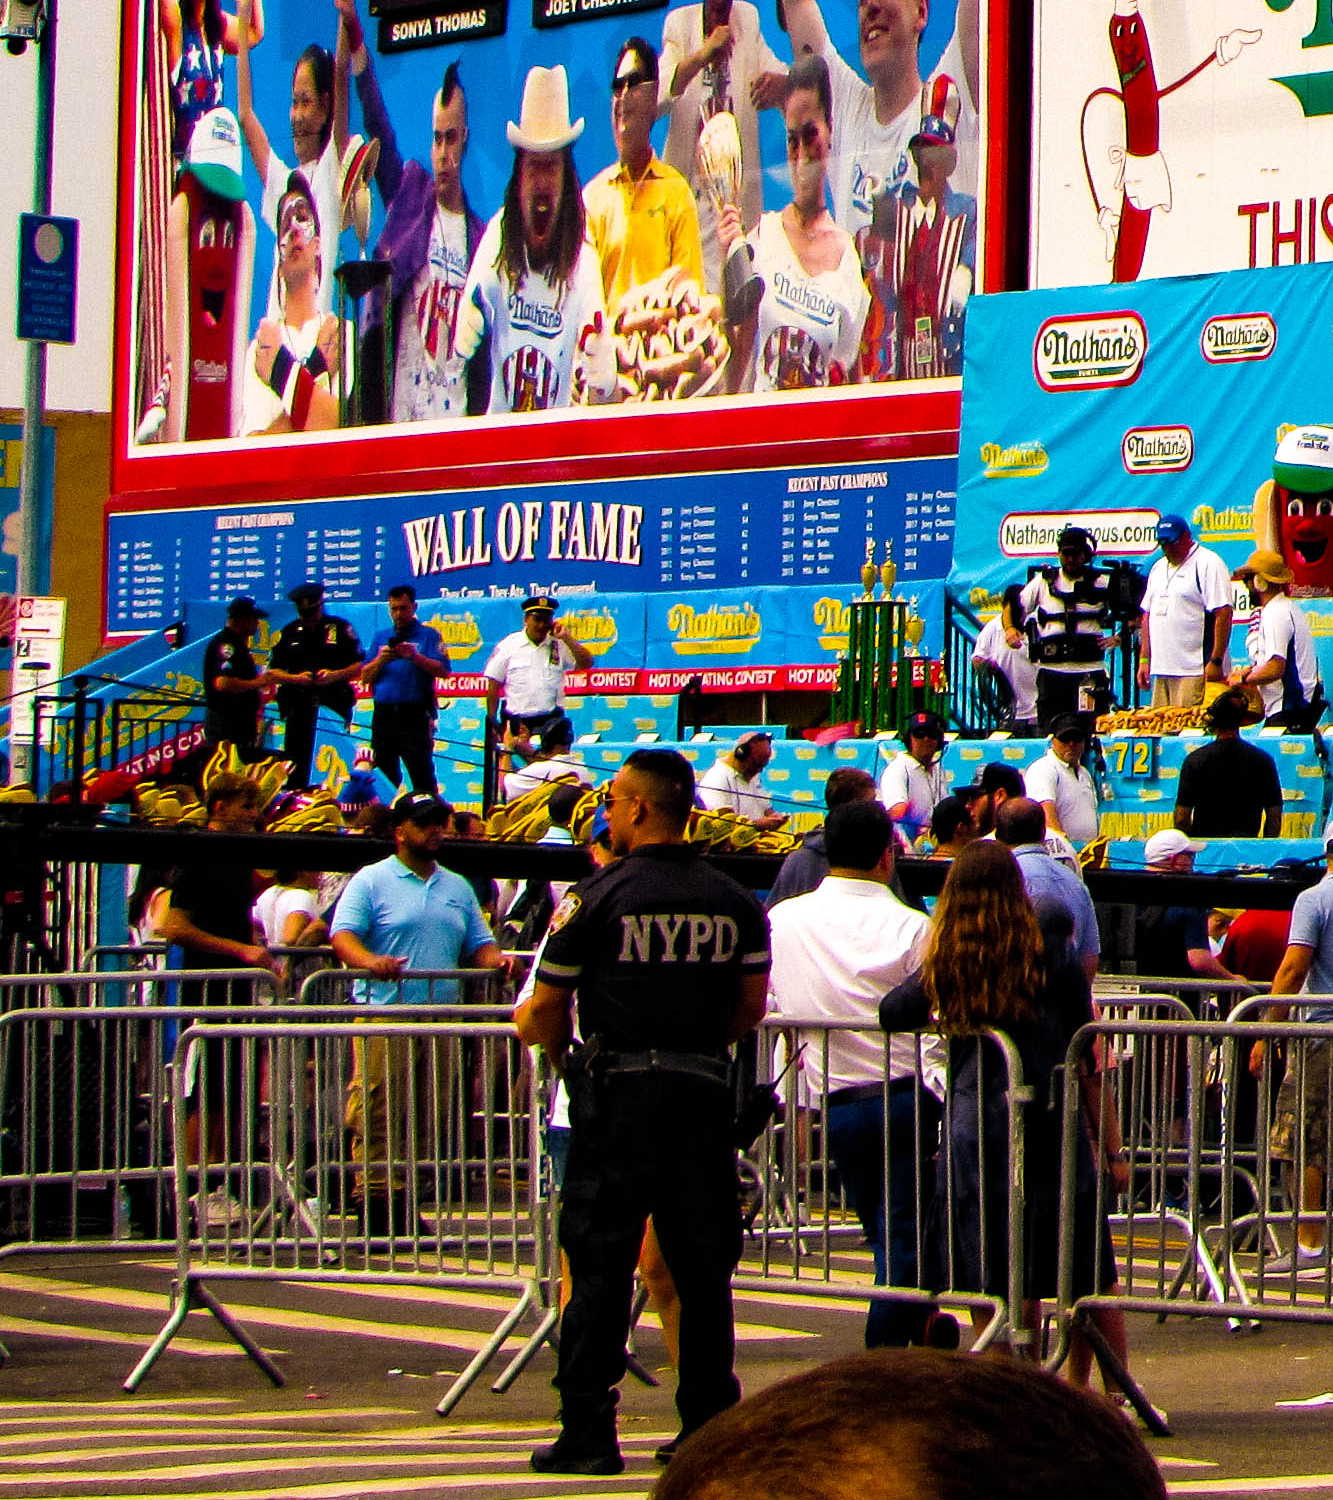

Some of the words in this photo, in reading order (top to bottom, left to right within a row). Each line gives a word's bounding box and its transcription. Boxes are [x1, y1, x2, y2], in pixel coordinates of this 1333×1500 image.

[392, 16, 433, 41] SONYA
[434, 9, 487, 36] THOMAS
[1042, 324, 1146, 368] Nathan's
[1207, 318, 1273, 351] Nathan's
[1126, 433, 1192, 465] Nathan's
[787, 475, 819, 493] RECENT
[820, 474, 840, 491] PAST
[840, 471, 889, 490] CHAMPIONS
[403, 505, 492, 578] WALL
[496, 501, 542, 563] OF
[548, 502, 644, 566] FAME
[590, 671, 638, 687] CONTEST
[649, 673, 672, 688] HOT
[788, 669, 809, 684] HOT
[1114, 740, 1149, 774] 72
[618, 914, 740, 964] NYPD
